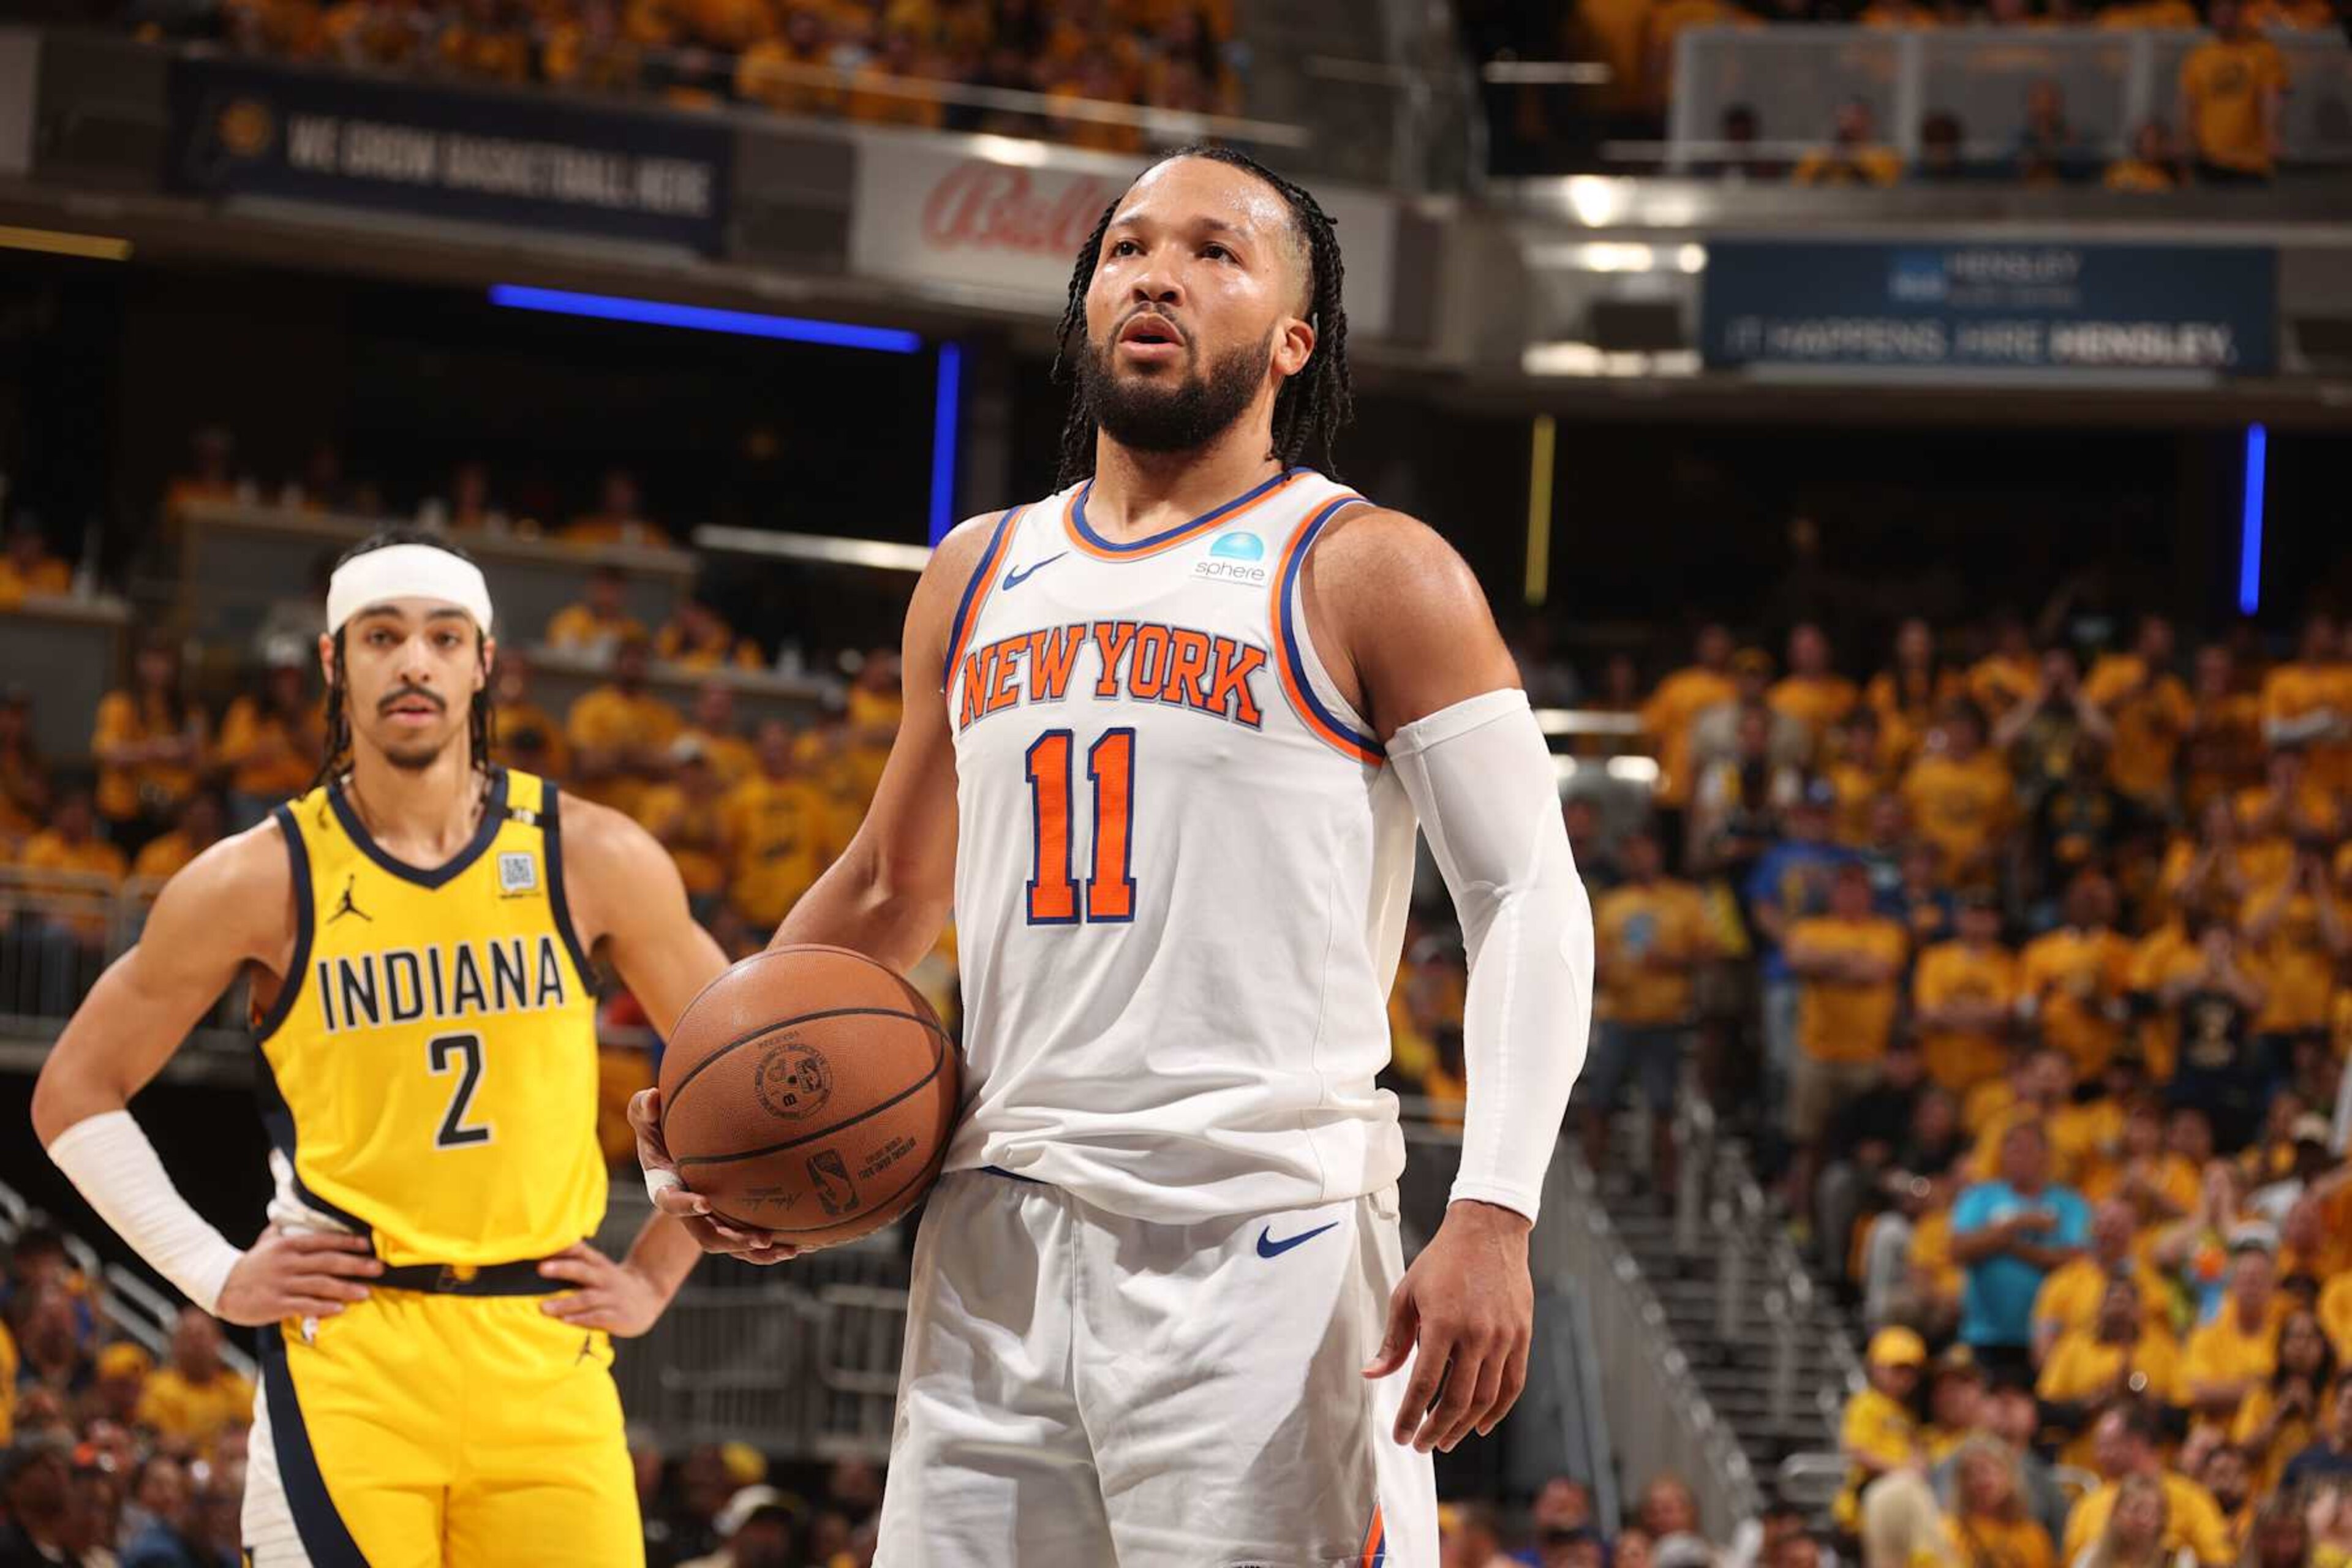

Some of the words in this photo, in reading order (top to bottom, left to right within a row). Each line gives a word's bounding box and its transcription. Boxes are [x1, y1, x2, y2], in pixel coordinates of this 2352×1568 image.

[287, 115, 337, 172] WE
[441, 134, 633, 205] BASKETBALL
[1194, 560, 1265, 581] sphere
[957, 622, 1088, 733] NEW
[1091, 620, 1267, 731] YORK
[1025, 727, 1137, 925] 11
[315, 935, 566, 1032] INDIANA
[428, 1032, 492, 1150] 2
